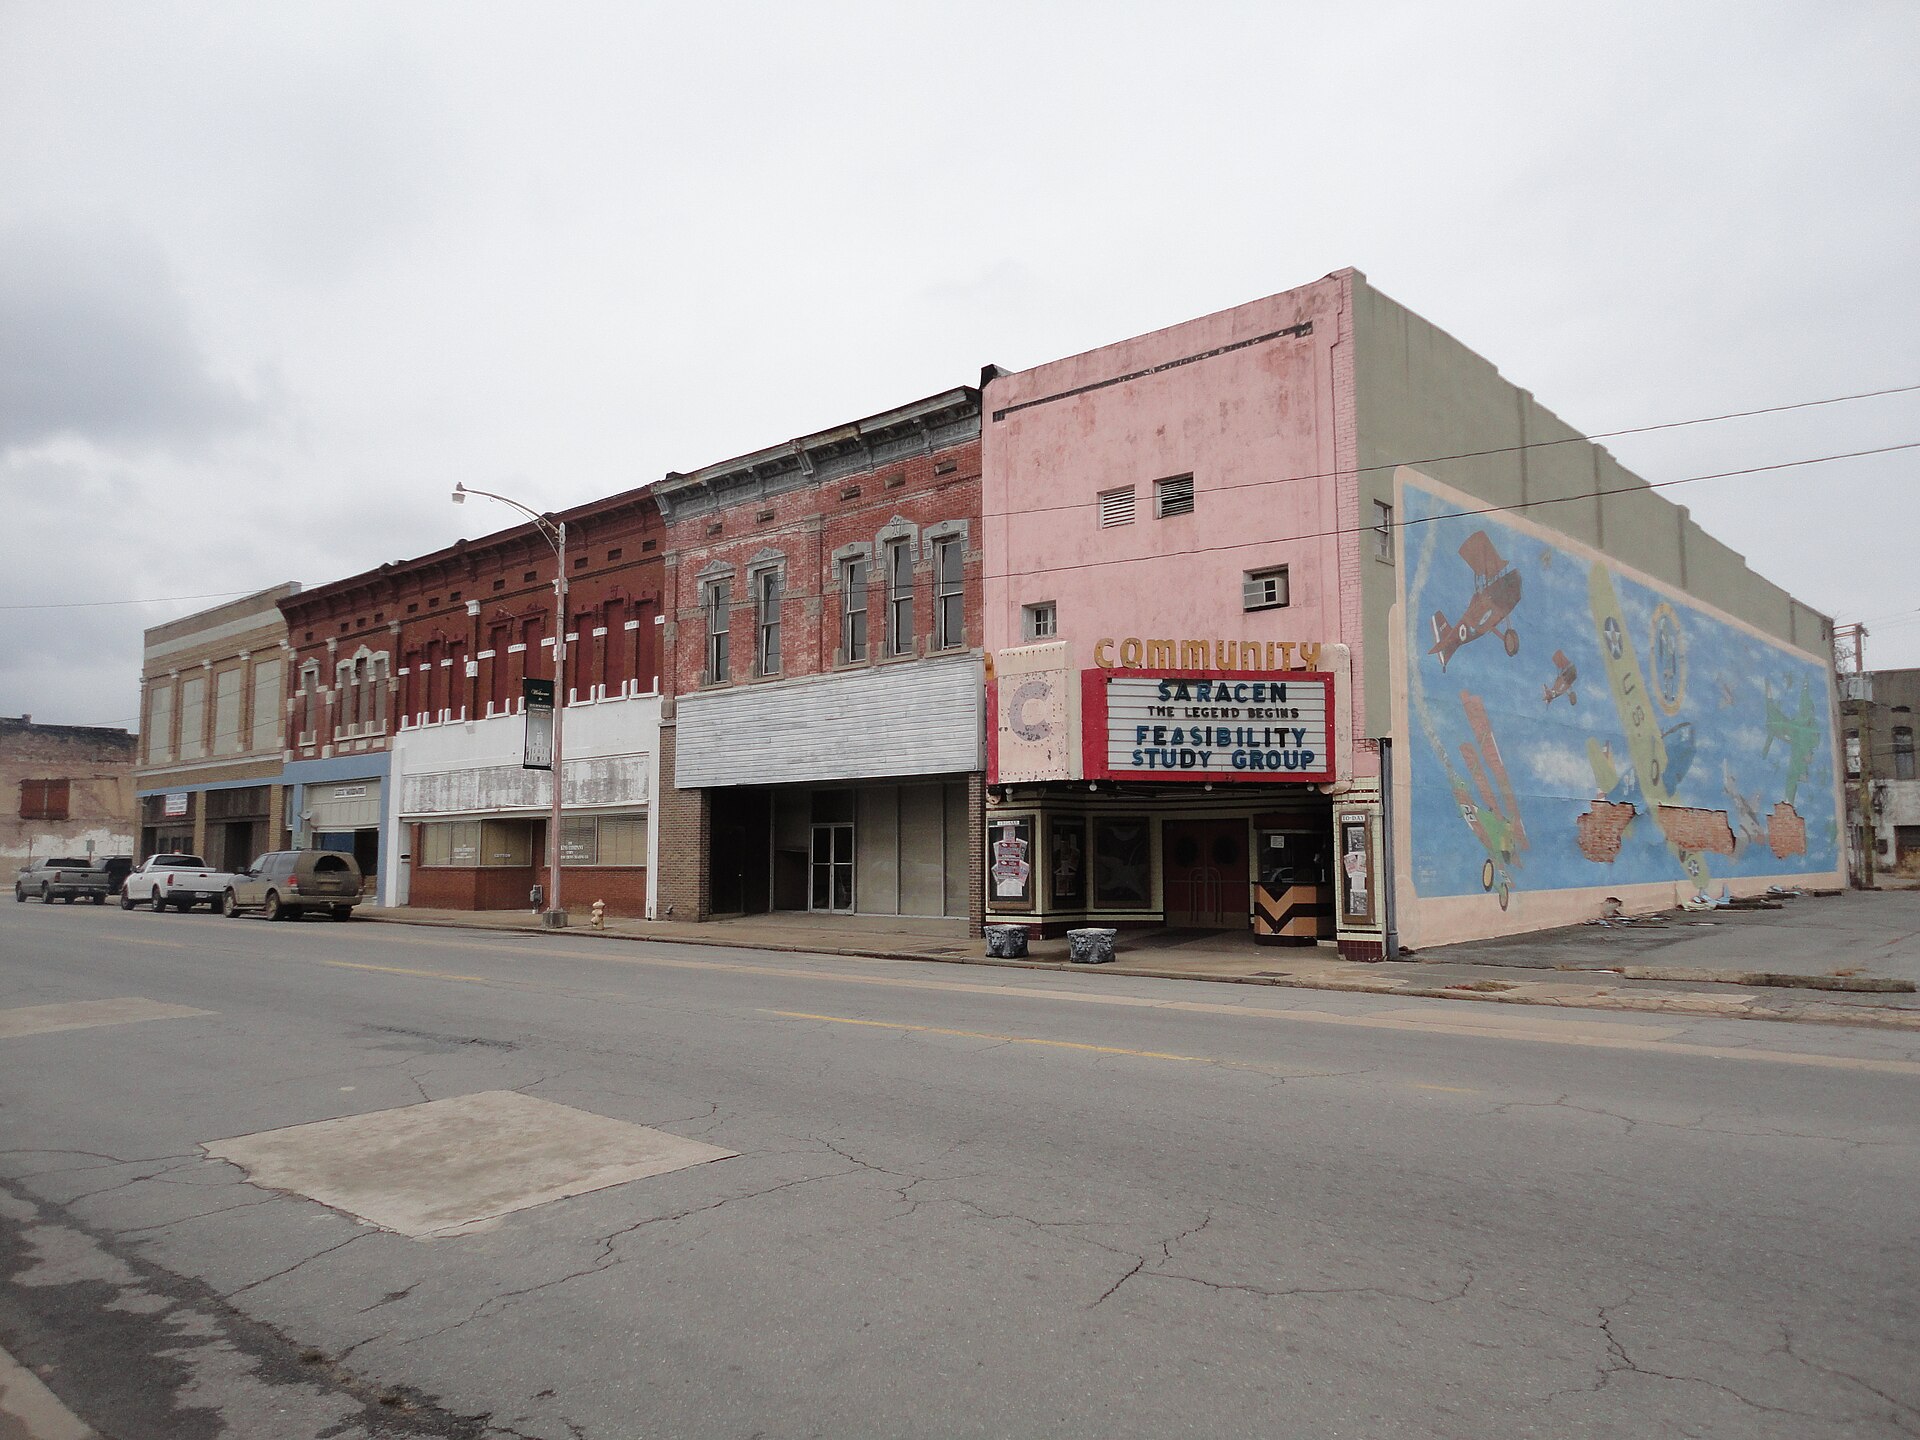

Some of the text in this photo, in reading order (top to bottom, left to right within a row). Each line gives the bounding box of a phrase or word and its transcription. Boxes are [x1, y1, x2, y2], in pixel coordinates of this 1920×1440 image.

[1094, 638, 1321, 671] COMMUNITY
[1158, 682, 1287, 703] SARACEN
[1009, 681, 1051, 742] C
[1148, 706, 1300, 718] THE LEGEND BEGINS
[1137, 725, 1306, 748] FEASIBILITY
[1132, 748, 1315, 770] STUDY GROUP
